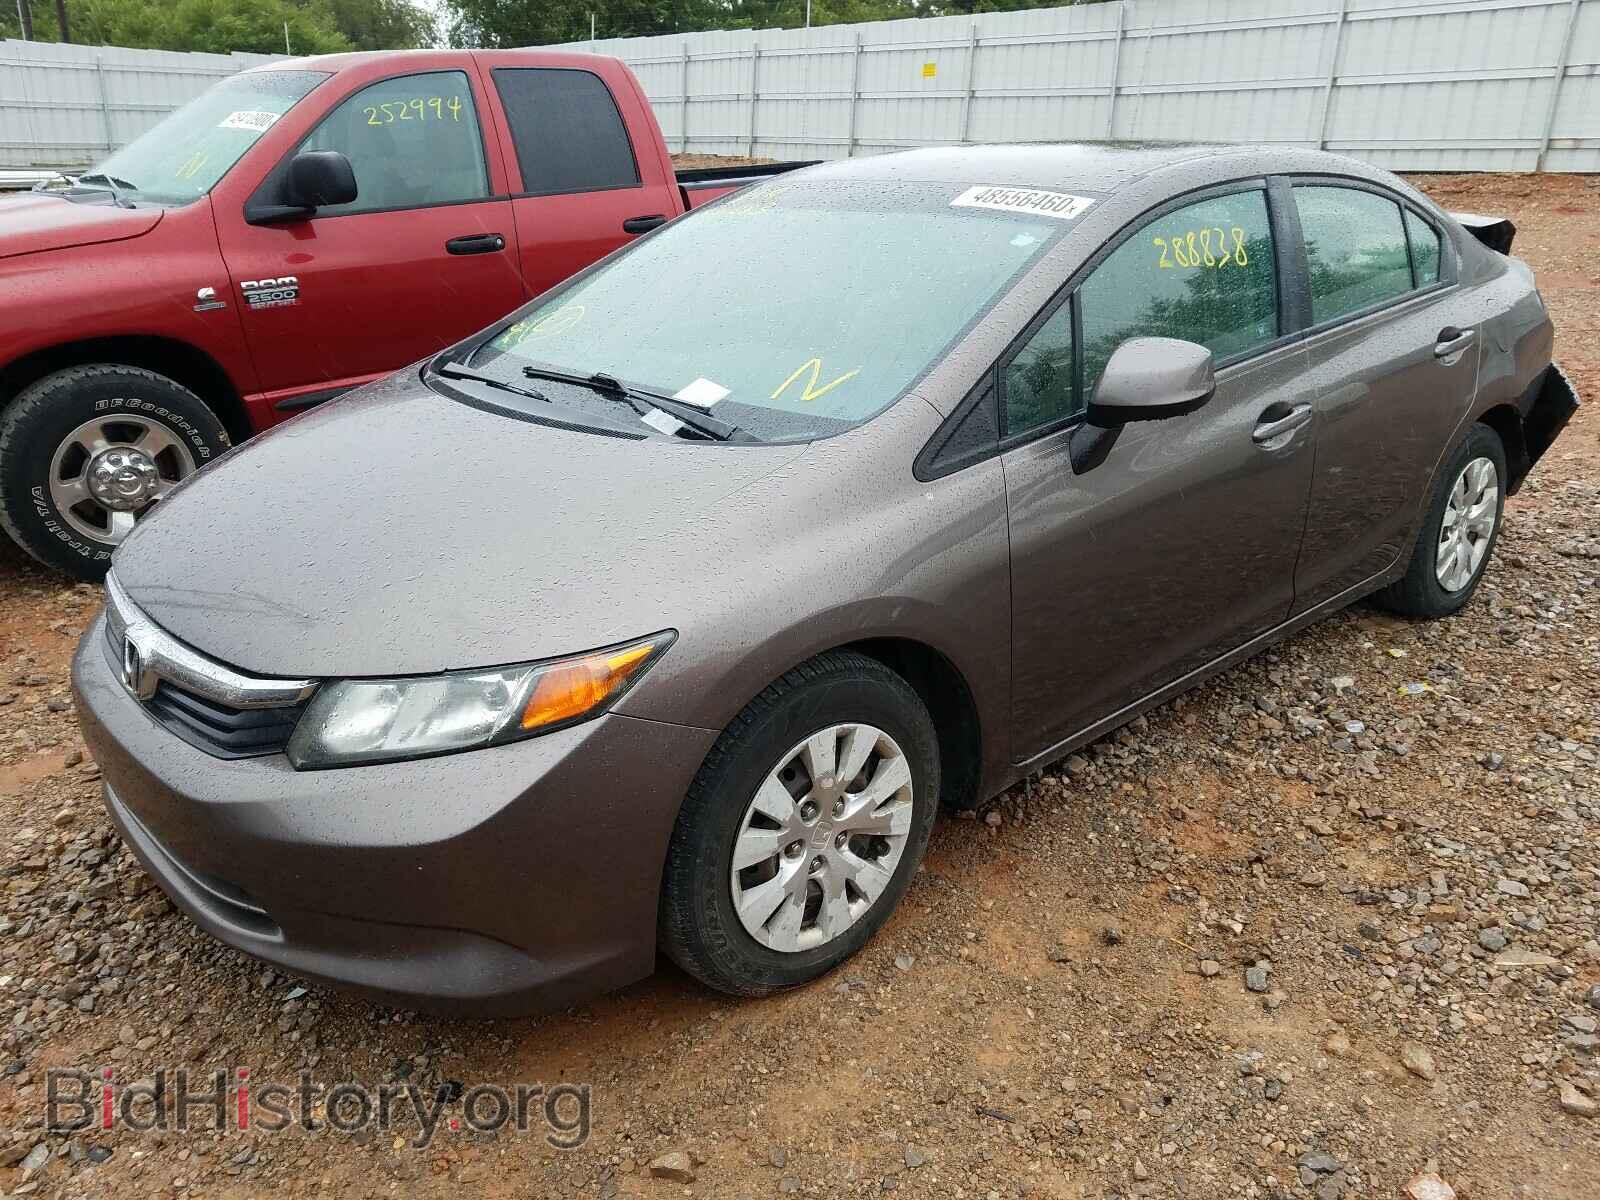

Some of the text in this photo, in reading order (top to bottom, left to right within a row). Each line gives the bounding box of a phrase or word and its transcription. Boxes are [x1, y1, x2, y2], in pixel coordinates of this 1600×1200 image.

[363, 96, 462, 125] 252994
[1153, 228, 1248, 269] 288838
[248, 290, 296, 304] 2500
